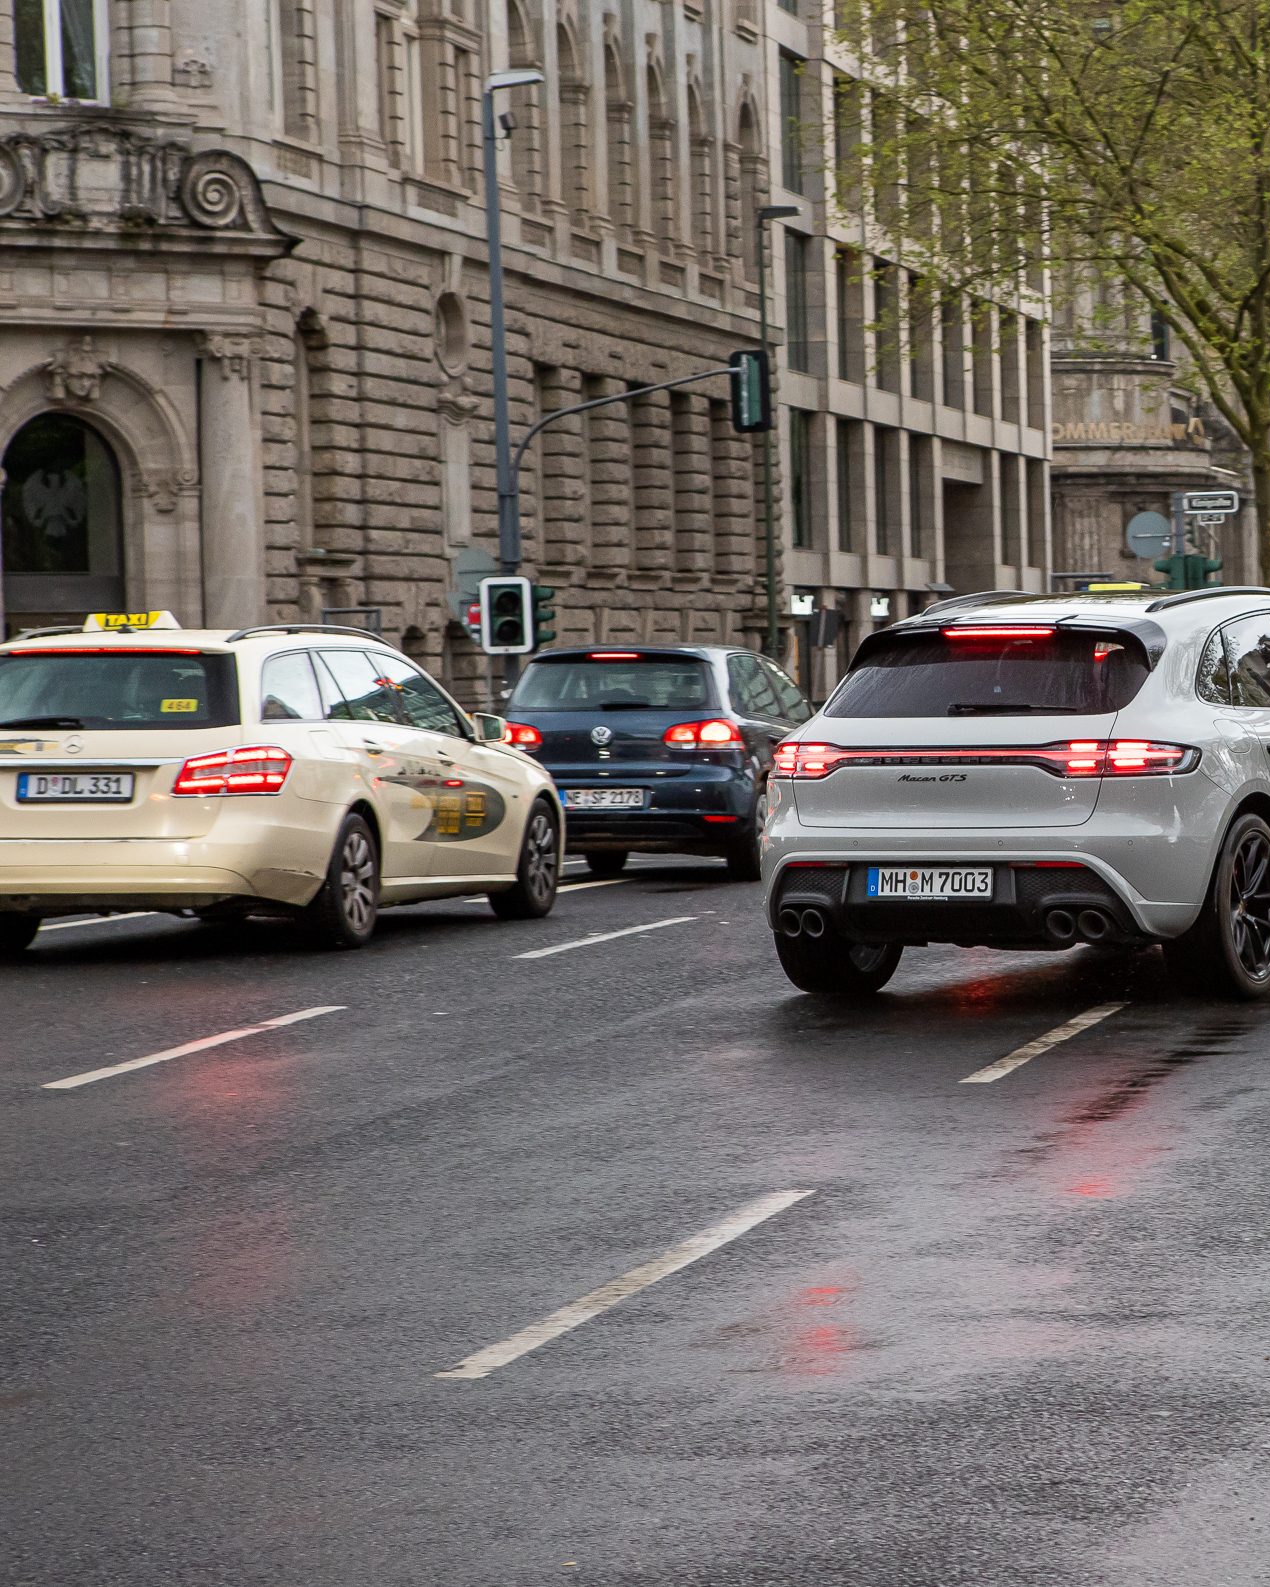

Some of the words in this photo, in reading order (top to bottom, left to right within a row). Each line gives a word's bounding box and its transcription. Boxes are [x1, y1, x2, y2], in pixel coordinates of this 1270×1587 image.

[105, 613, 148, 627] TAXI
[36, 777, 48, 794] D
[61, 777, 84, 794] DL
[89, 777, 123, 794] 331
[898, 774, 937, 783] Macan
[939, 774, 967, 782] GTS
[610, 791, 640, 804] 2178
[881, 871, 907, 893] MH
[938, 871, 989, 893] 7003
